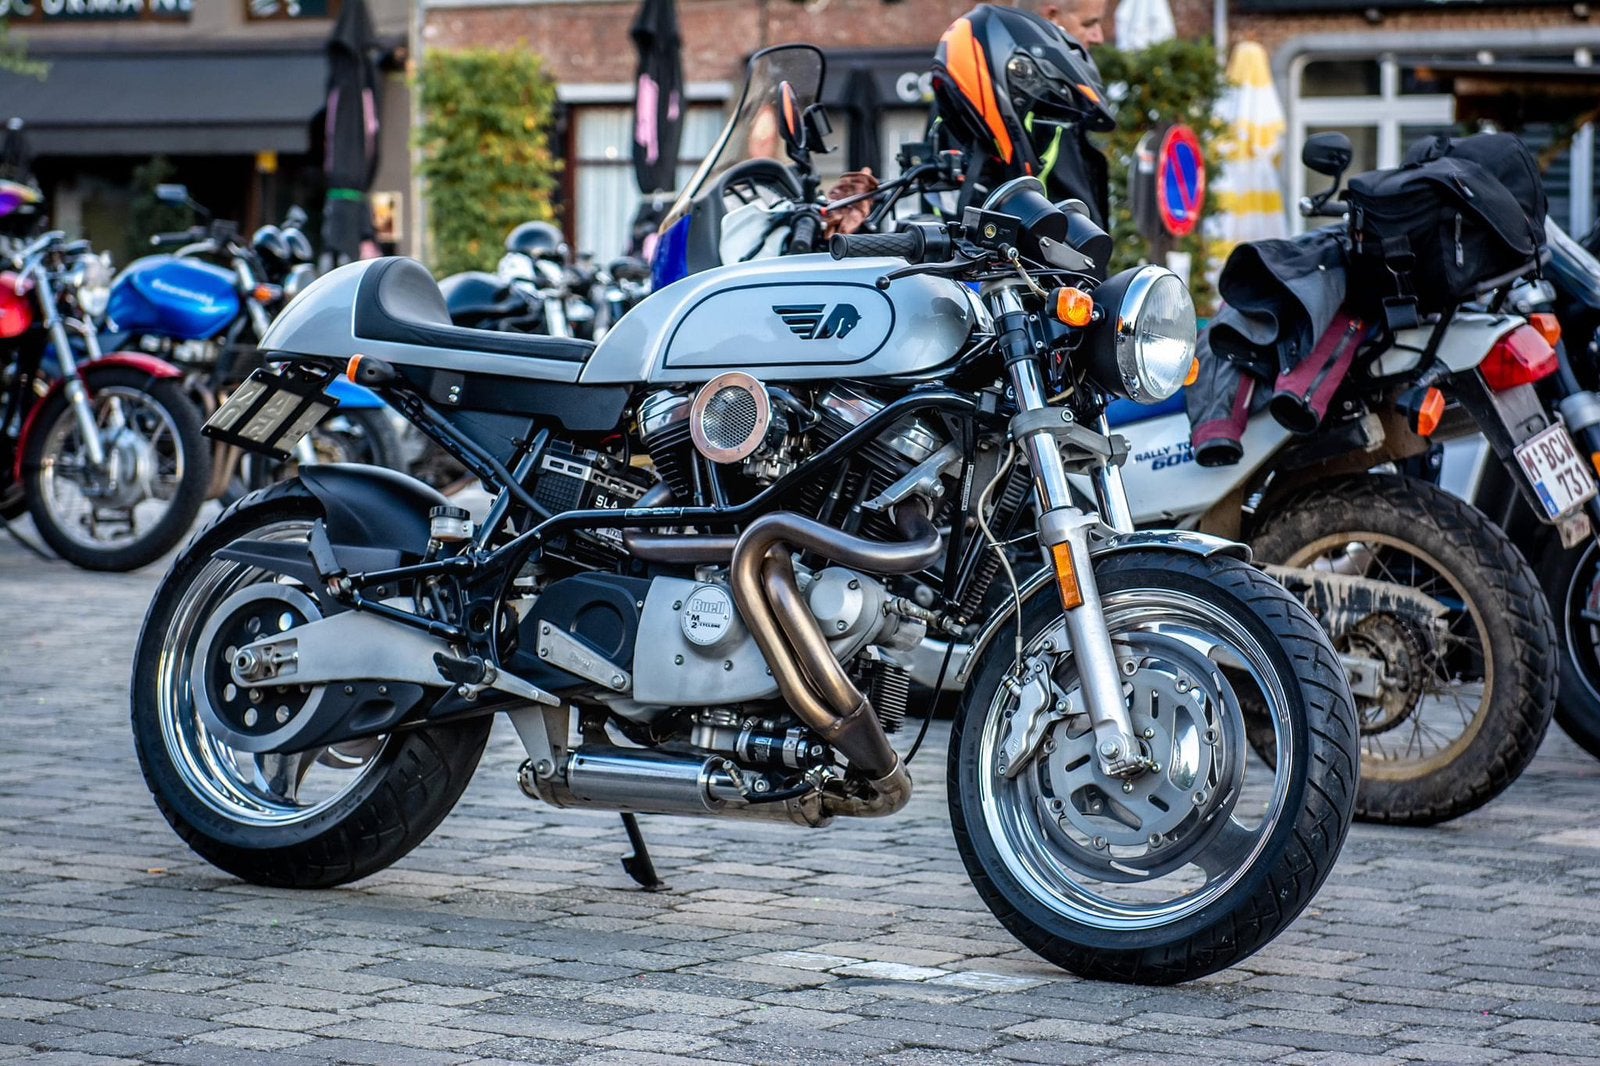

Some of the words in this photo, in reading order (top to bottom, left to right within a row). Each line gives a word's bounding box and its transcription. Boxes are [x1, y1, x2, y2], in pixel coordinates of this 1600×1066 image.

[1135, 446, 1170, 461] RALLY
[1556, 462, 1592, 502] 731
[692, 599, 725, 614] Buell
